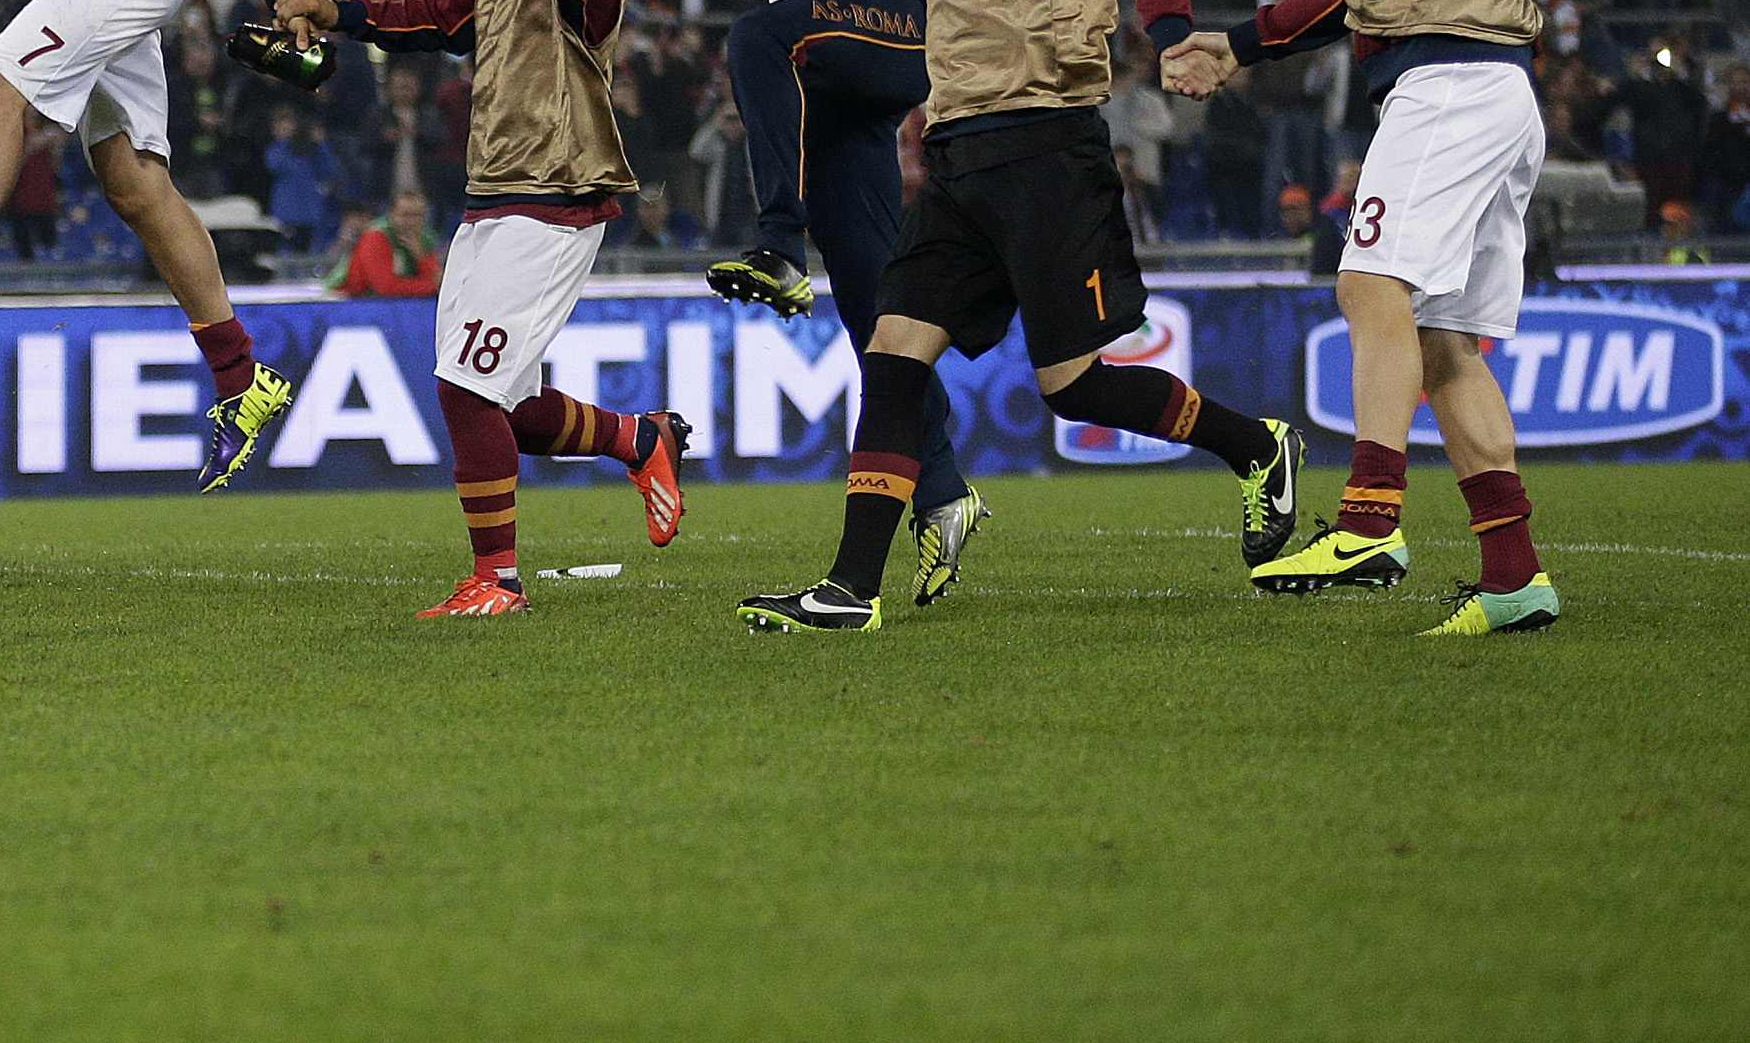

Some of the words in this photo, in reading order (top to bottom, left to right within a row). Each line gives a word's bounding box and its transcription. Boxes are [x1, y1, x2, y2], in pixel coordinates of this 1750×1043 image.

[18, 25, 66, 67] 7
[1085, 268, 1106, 321] 1
[456, 318, 509, 375] 18
[1503, 331, 1675, 413] TIM
[268, 327, 441, 469] A
[540, 320, 865, 461] TIM
